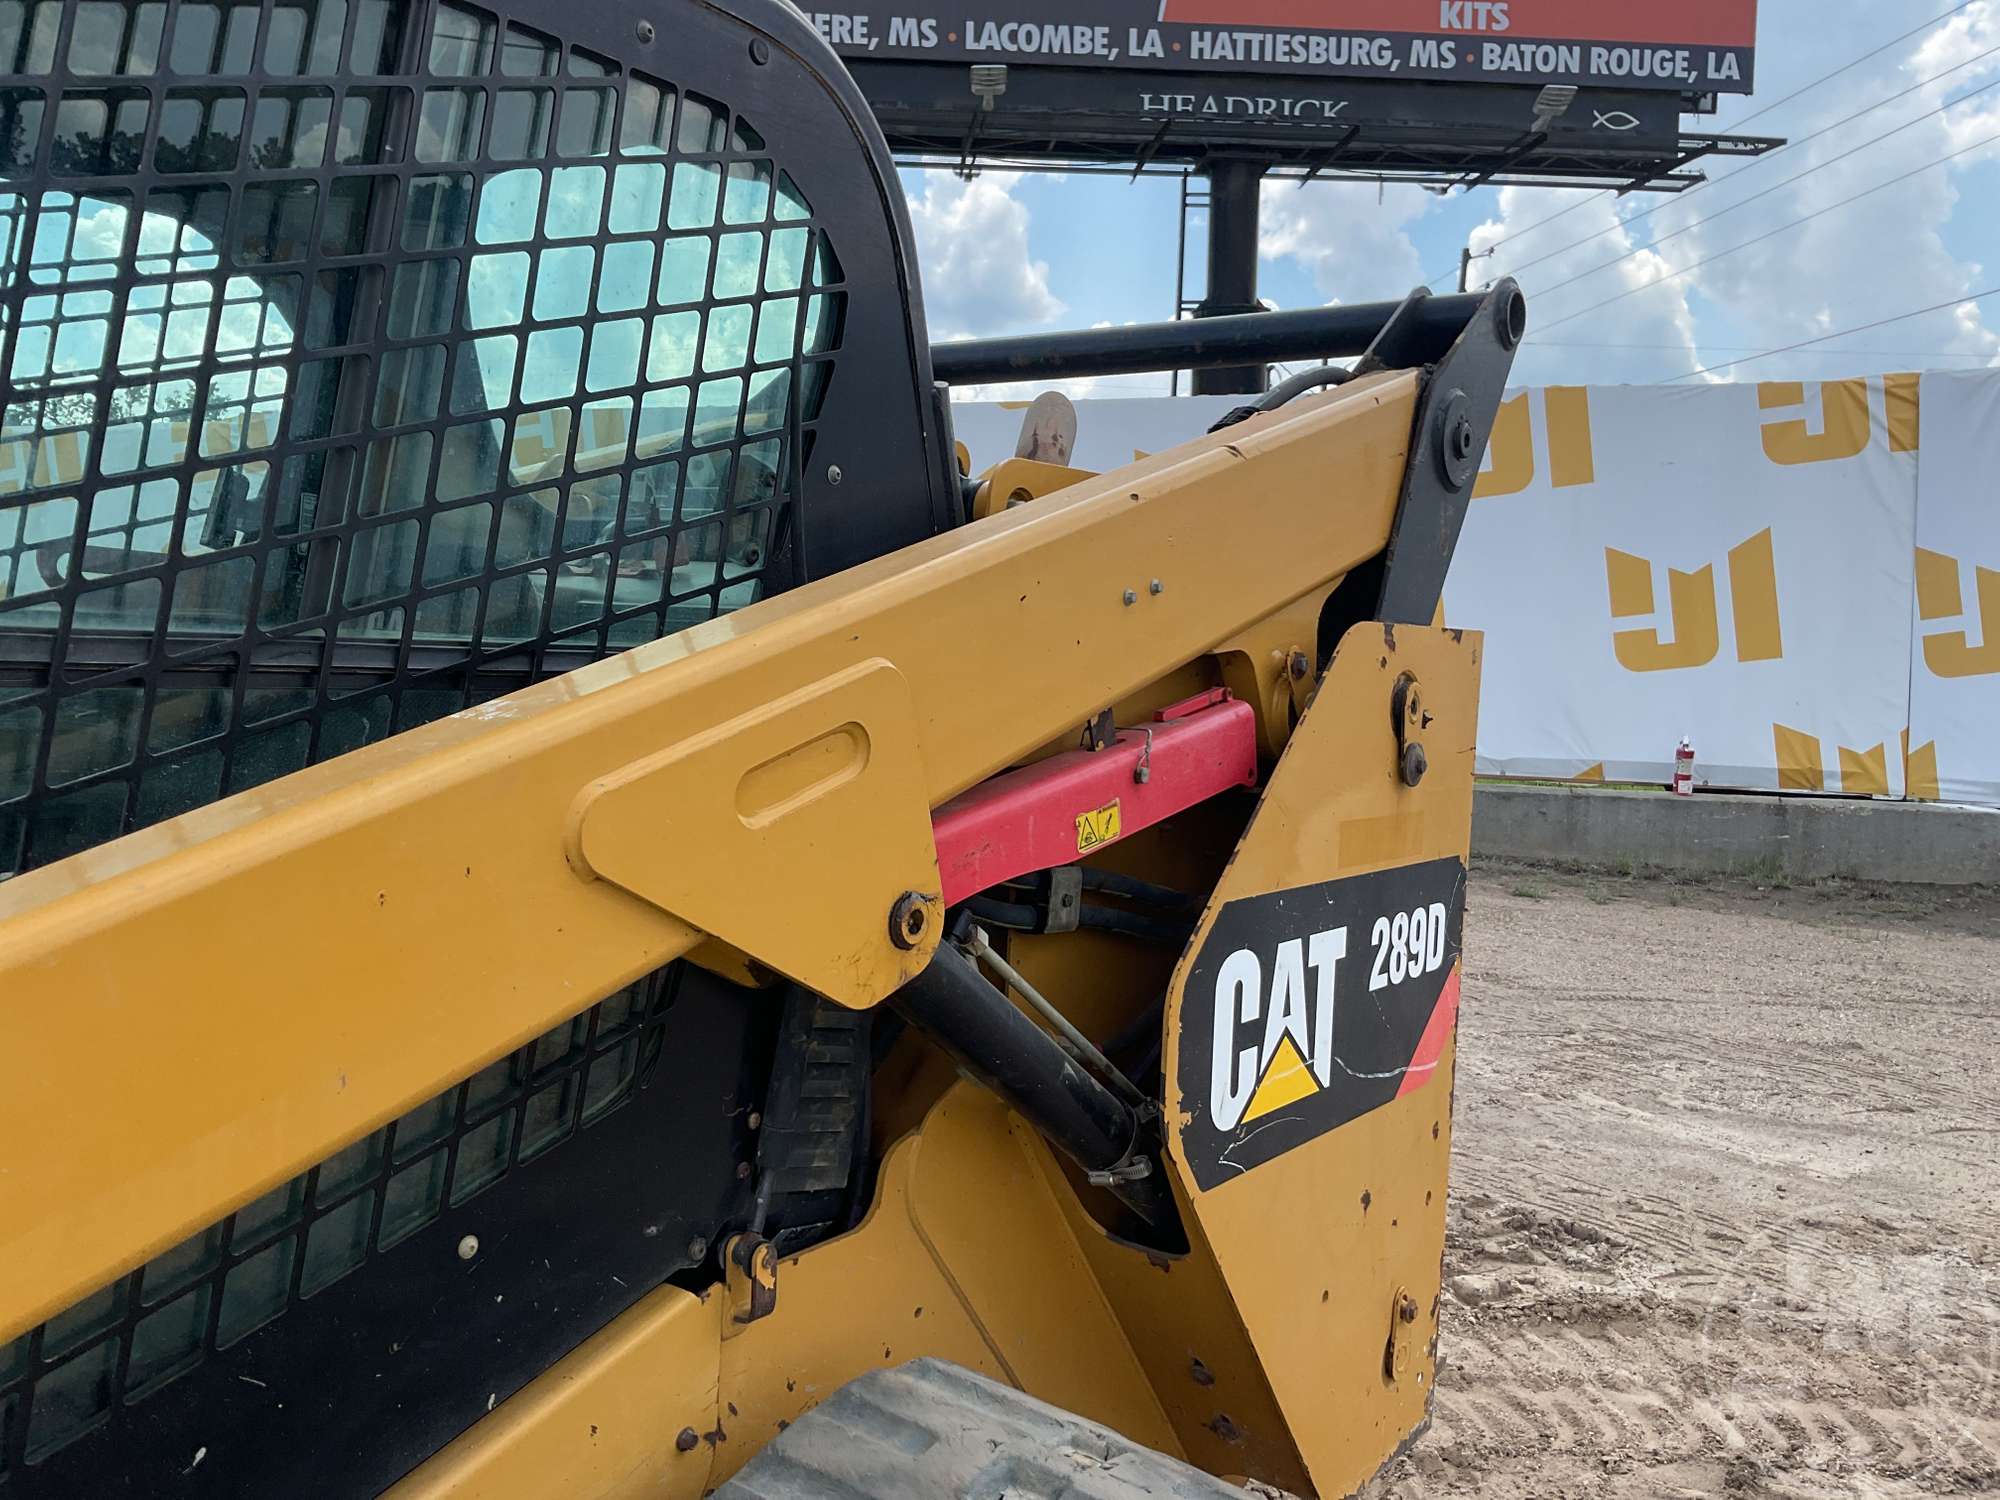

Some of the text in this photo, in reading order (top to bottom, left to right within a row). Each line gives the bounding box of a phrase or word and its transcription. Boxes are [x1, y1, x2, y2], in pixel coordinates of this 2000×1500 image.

[1439, 0, 1511, 31] KITS
[888, 16, 938, 48] MS
[965, 20, 1120, 61] LACOMBE,
[1128, 27, 1165, 58] LA
[1189, 30, 1401, 72] HATTIESBURG,
[1408, 39, 1457, 69] MS
[1481, 42, 1580, 75] BATON
[1589, 46, 1699, 84] ROUGE,
[1706, 51, 1741, 81] LA
[1210, 902, 1447, 1132] CAT 289D
